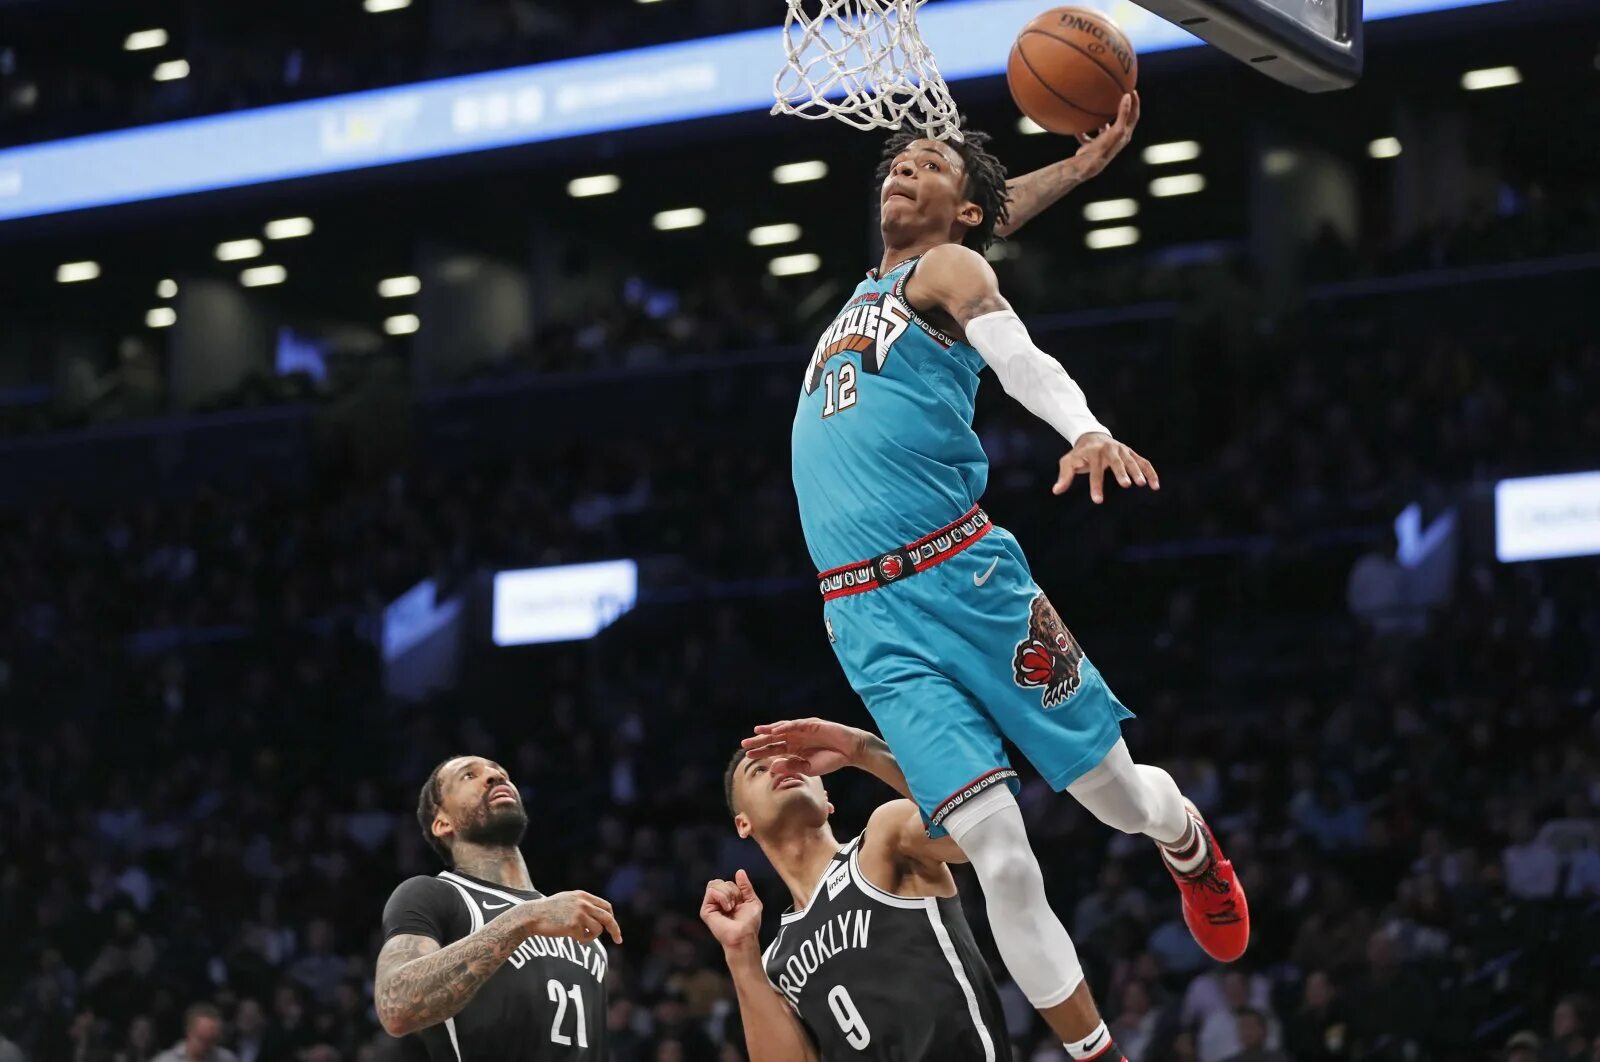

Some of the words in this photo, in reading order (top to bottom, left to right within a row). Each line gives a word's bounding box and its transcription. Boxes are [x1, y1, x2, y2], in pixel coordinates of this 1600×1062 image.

[821, 361, 857, 420] 12
[829, 870, 847, 891] infor
[778, 909, 872, 1004] ROOKLYN
[547, 979, 589, 1048] 21
[827, 984, 871, 1051] 9
